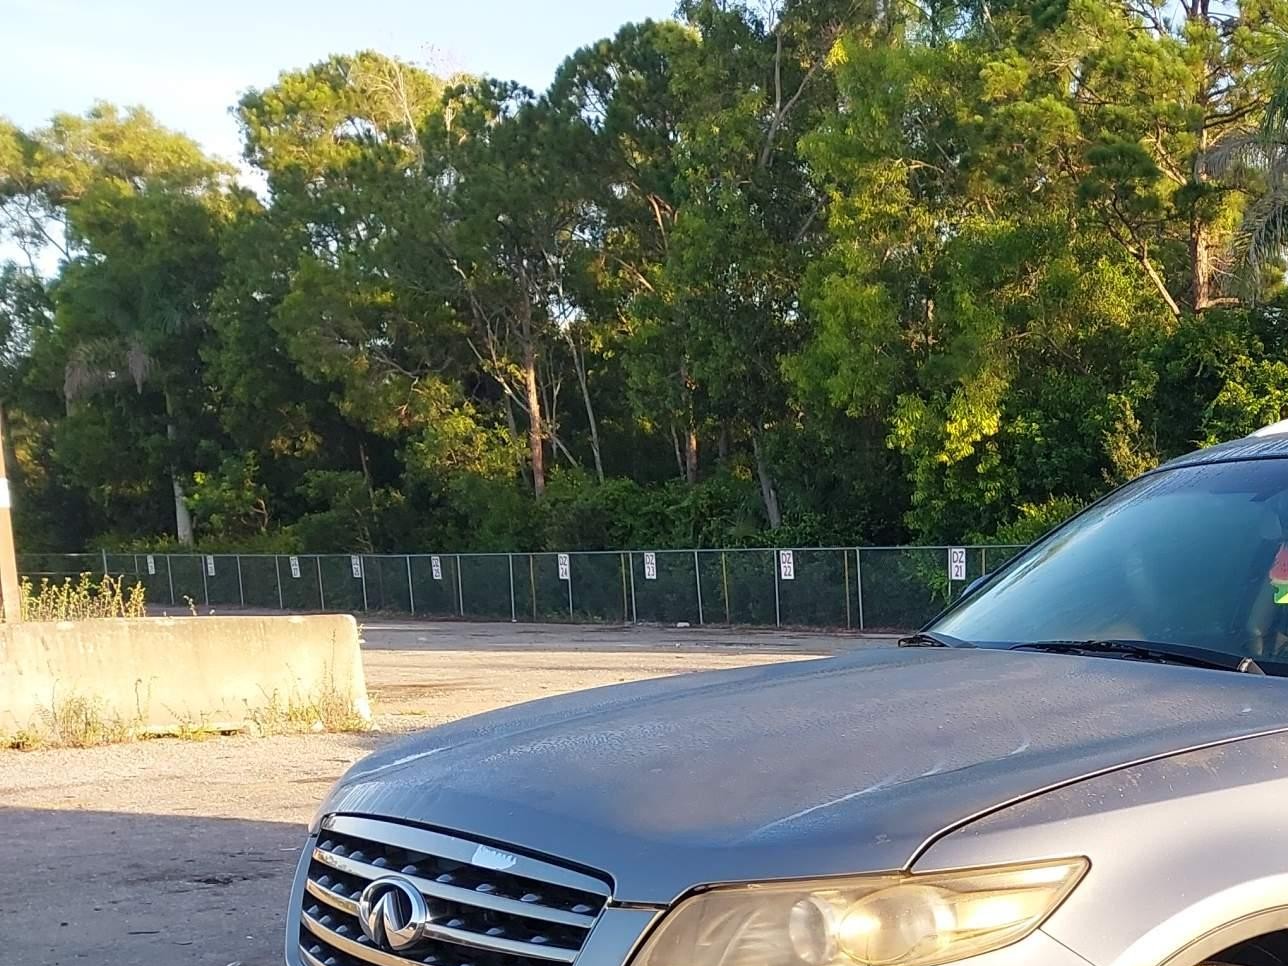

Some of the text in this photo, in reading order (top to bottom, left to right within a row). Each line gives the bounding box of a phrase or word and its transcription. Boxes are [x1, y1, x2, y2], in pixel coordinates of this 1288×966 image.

[645, 554, 655, 565] DZ
[782, 552, 792, 564] DZ
[953, 551, 965, 563] DZ
[646, 566, 656, 577] 23
[783, 565, 792, 577] 22
[954, 564, 963, 577] 21
